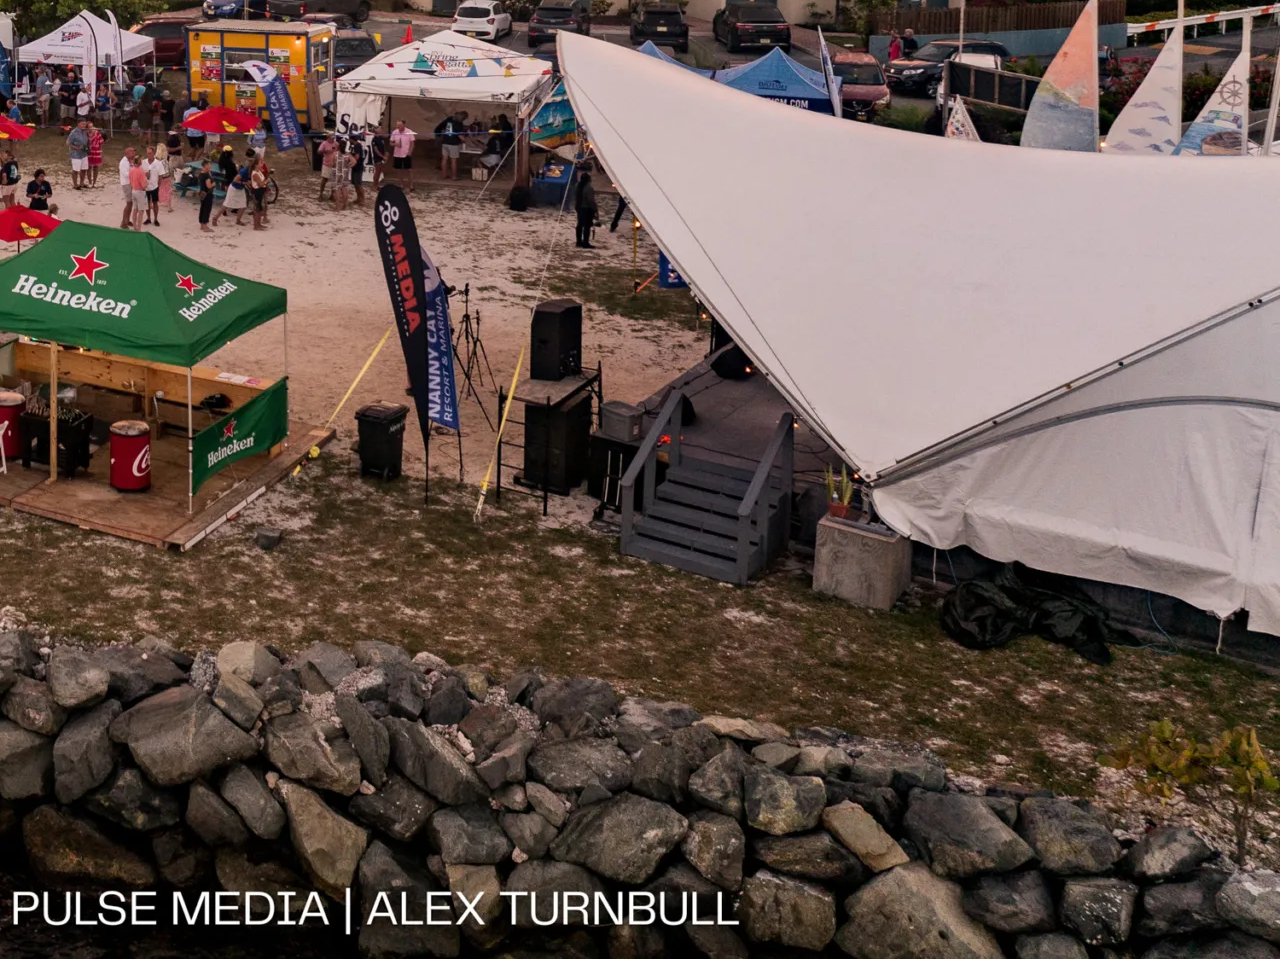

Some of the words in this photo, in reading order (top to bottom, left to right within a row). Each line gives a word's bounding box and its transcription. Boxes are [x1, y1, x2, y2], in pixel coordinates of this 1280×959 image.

[430, 60, 473, 69] Rgatt
[275, 80, 289, 111] MARINA
[273, 112, 292, 148] NANNY
[11, 274, 134, 319] Heineken
[178, 281, 237, 322] Heineken
[390, 233, 421, 334] MEDIA
[427, 308, 437, 344] CAY
[436, 296, 450, 353] MARINA
[441, 357, 448, 366] &
[428, 348, 442, 419] NANNY
[443, 370, 453, 422] RESORT
[207, 436, 255, 468] Heineken
